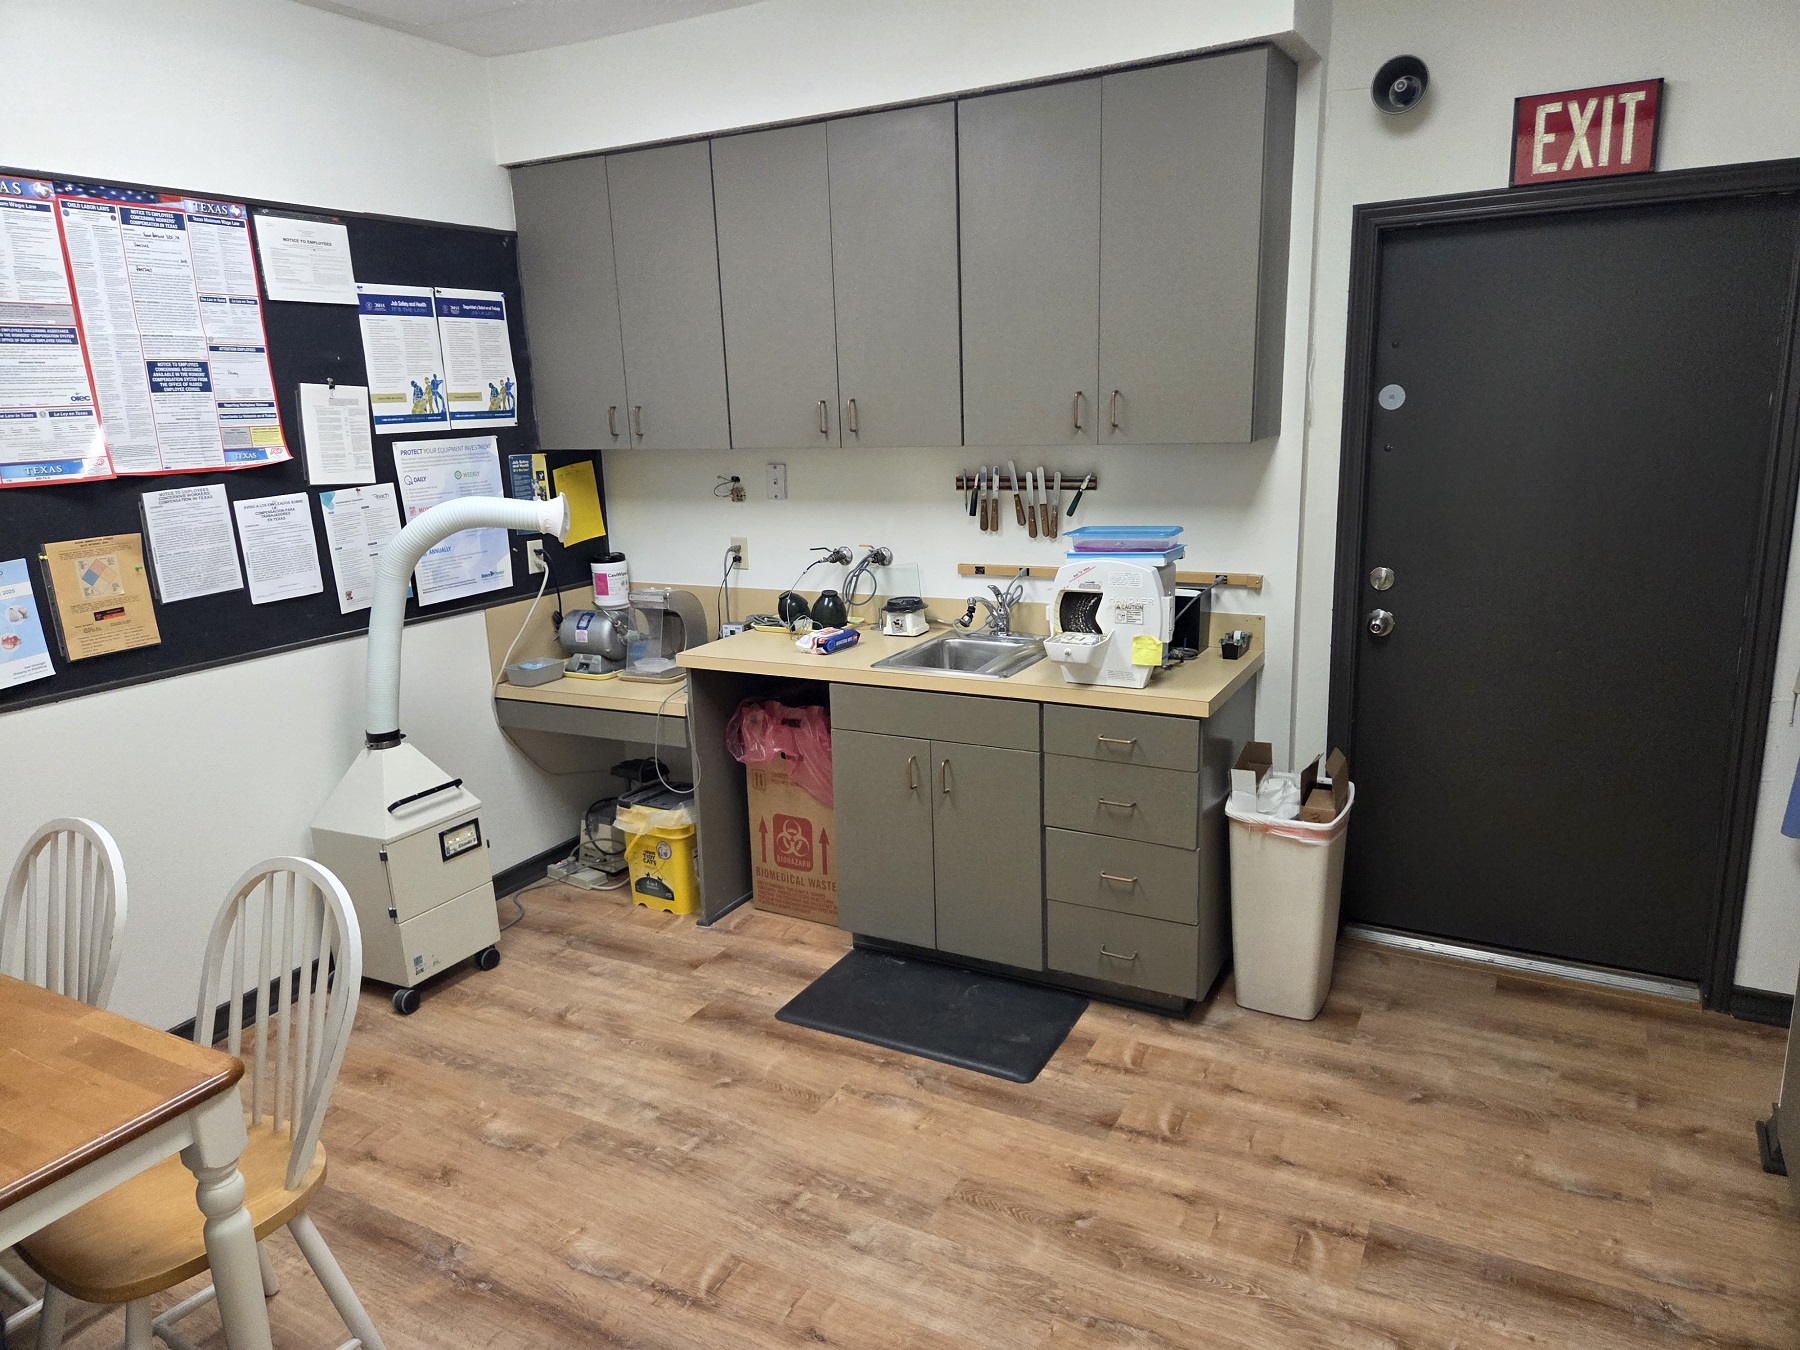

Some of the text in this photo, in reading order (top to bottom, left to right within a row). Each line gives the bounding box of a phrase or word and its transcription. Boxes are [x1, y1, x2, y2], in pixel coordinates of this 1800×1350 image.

[1532, 90, 1646, 174] EXIT
[193, 202, 228, 214] TEXAS
[464, 443, 491, 451] INVESTMENT
[25, 465, 63, 475] TEXAS
[428, 546, 452, 555] ANNUALLY
[1109, 596, 1154, 606] HANDLER
[777, 856, 811, 867] BIOHAZARD
[756, 866, 837, 891] BIOMEDICAL WASTE
